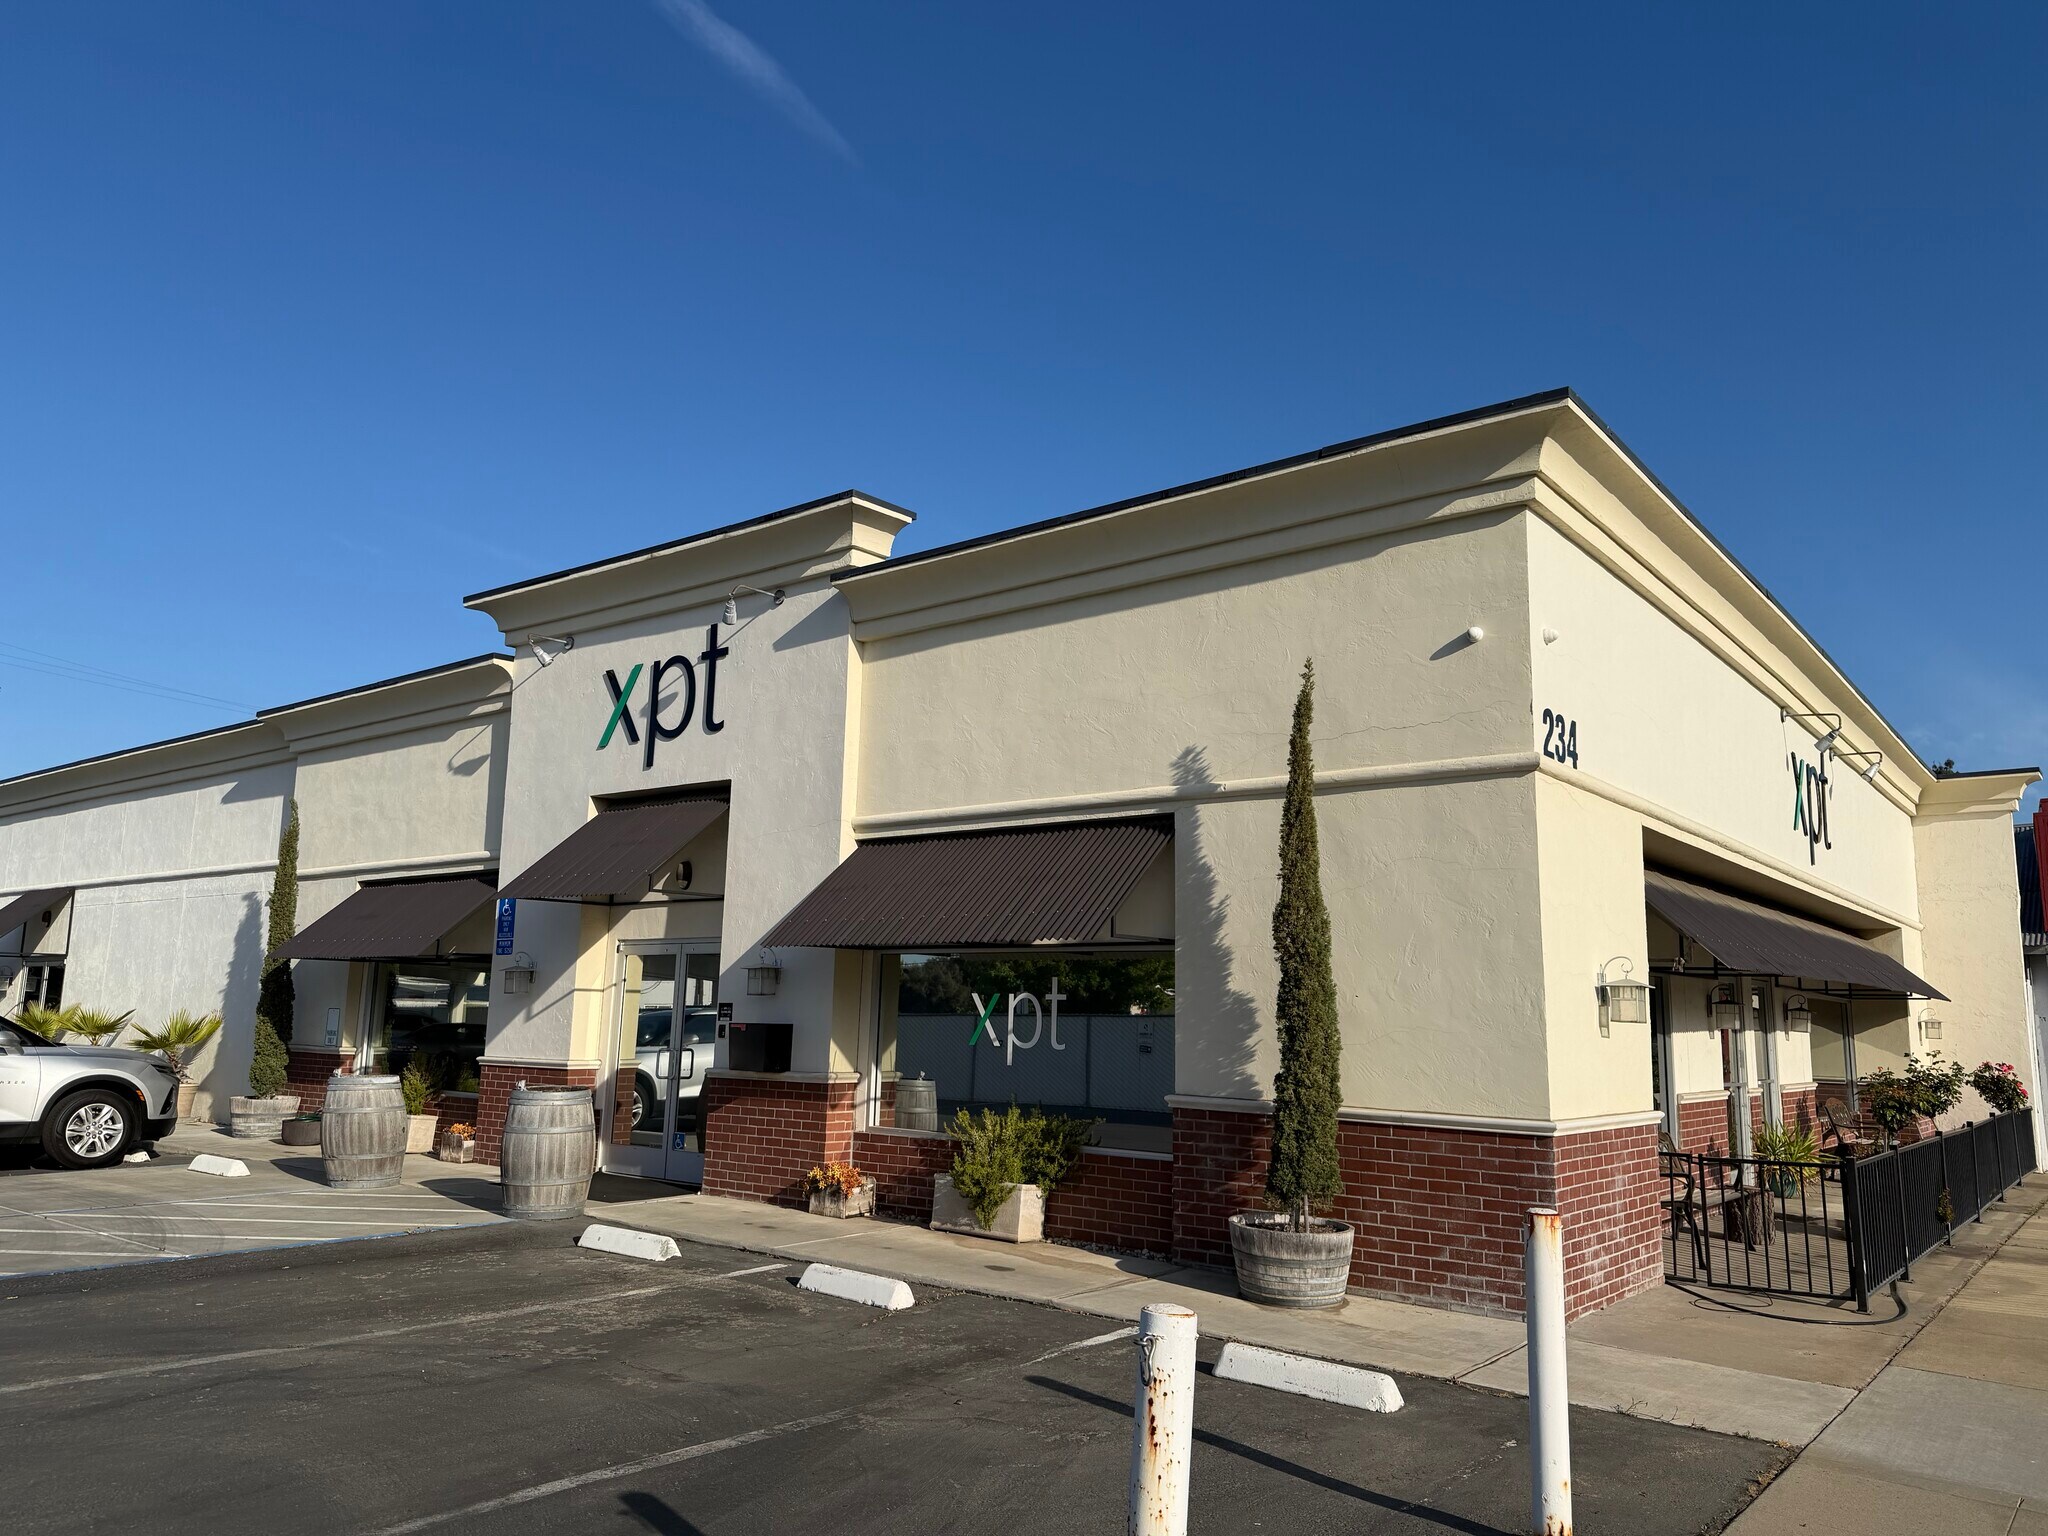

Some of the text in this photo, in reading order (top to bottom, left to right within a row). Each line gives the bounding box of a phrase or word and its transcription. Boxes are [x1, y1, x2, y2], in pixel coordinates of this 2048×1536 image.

[598, 623, 729, 768] xpt
[1542, 708, 1578, 770] 234
[1791, 751, 1832, 866] xpt
[968, 976, 1067, 1066] xpt
